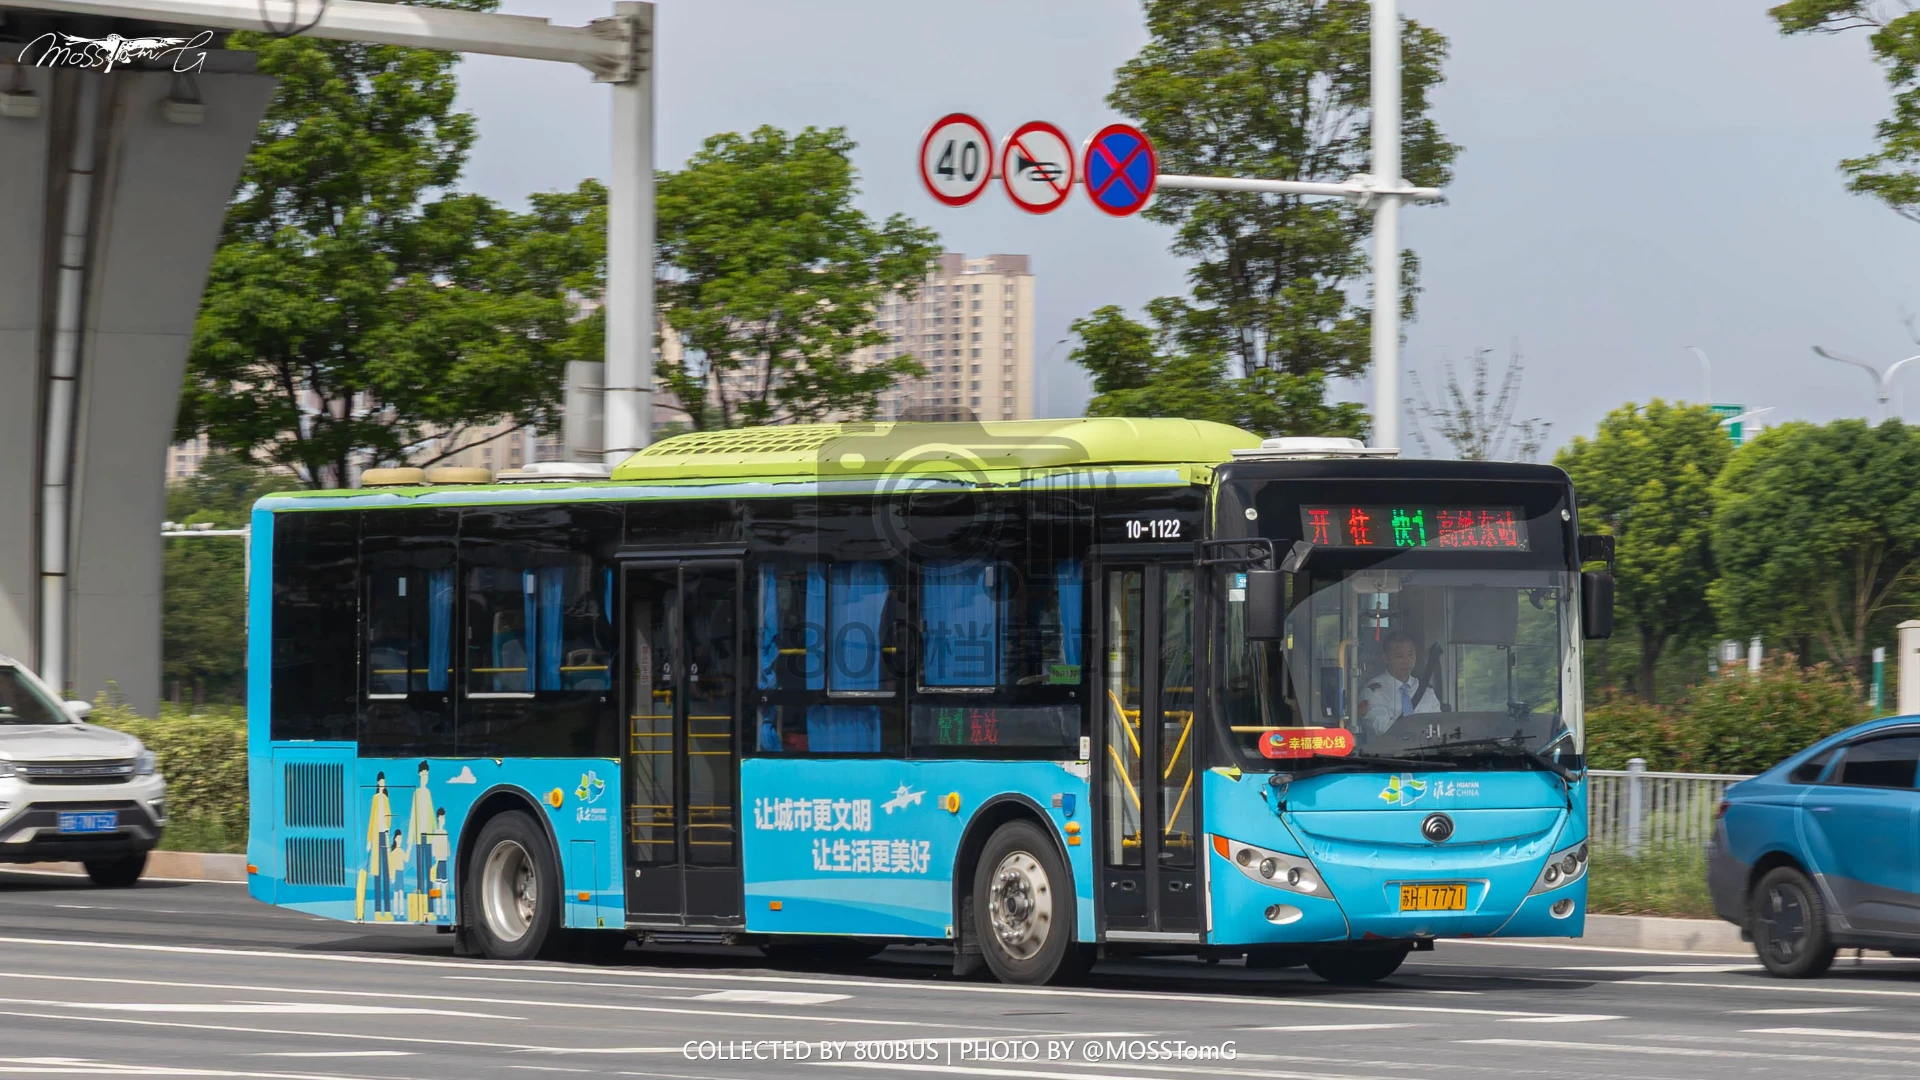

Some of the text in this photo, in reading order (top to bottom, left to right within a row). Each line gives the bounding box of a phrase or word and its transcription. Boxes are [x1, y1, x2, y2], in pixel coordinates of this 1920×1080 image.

[935, 139, 979, 181] 40
[1125, 519, 1180, 538] 10-1122
[1288, 736, 1346, 750] 幸福爱心线
[754, 797, 872, 832] 让城市更文明
[812, 838, 931, 874] 让生活更美好
